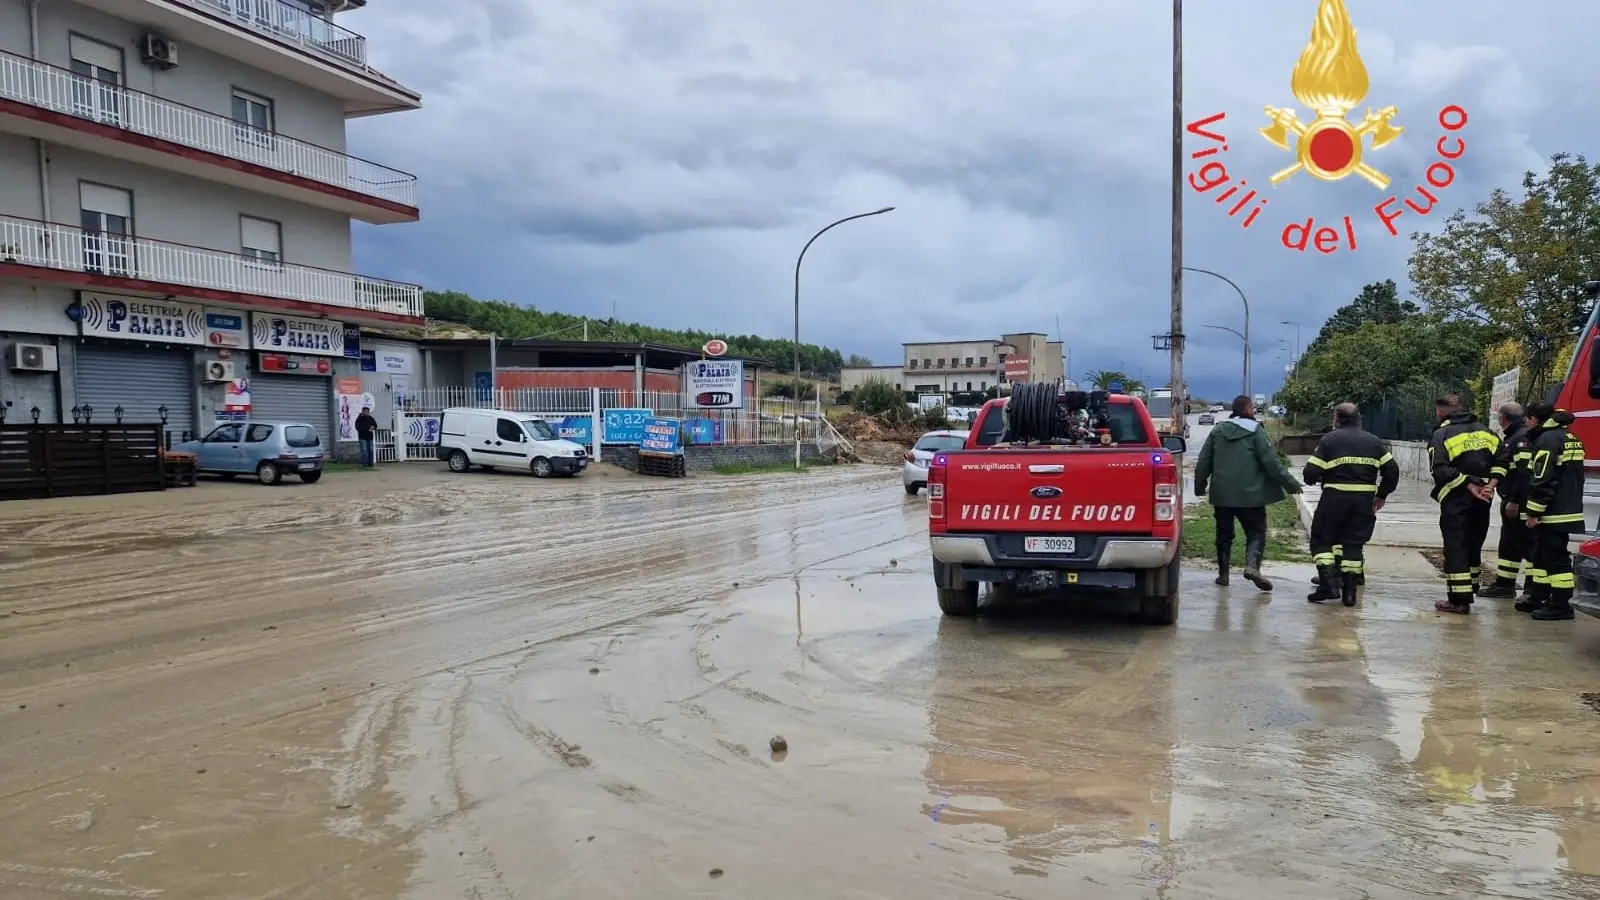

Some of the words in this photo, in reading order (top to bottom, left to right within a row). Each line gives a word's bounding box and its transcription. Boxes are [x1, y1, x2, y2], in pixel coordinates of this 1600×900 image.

[129, 302, 184, 318] ELETTRICA
[106, 300, 186, 338] PALAIA
[288, 320, 329, 333] ELETTRICA
[271, 318, 330, 350] PALAIA
[698, 364, 731, 377] PALAIA
[712, 394, 730, 404] TIM
[962, 463, 1022, 471] www.vigilfuoco.it
[960, 505, 1021, 520] VIGILI
[1028, 505, 1062, 520] DEL
[1071, 505, 1136, 521] FUOCO
[1027, 538, 1037, 549] VF
[1044, 538, 1073, 550] 30992
